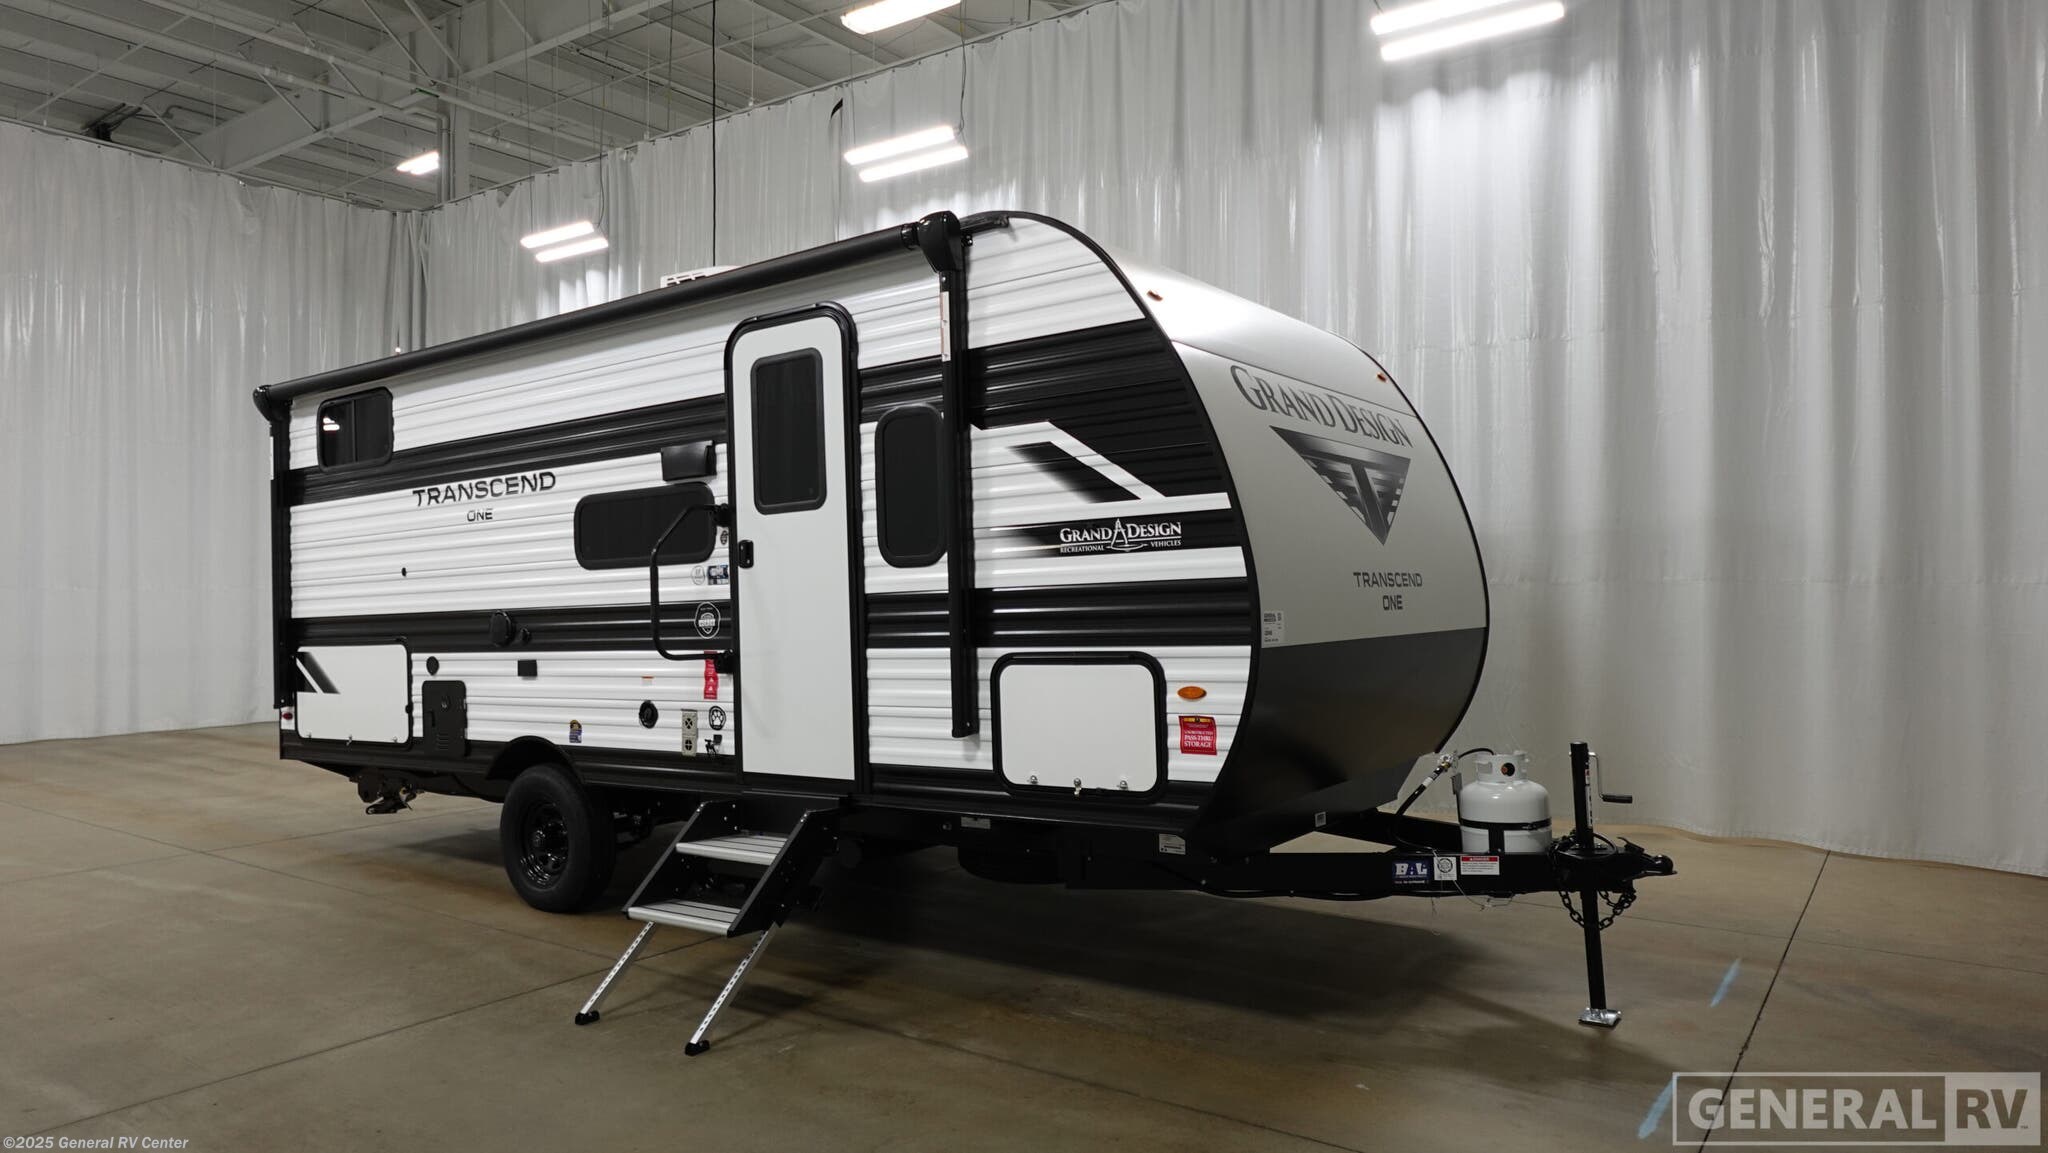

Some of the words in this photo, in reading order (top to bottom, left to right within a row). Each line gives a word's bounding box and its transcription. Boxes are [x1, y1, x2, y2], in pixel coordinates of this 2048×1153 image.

[1230, 365, 1336, 428] GRAND
[1325, 394, 1414, 448] DESIGN
[412, 471, 556, 507] TRANSCEND
[467, 508, 493, 522] ONE
[1060, 527, 1113, 543] GRAND
[1126, 522, 1182, 538] DESIGN
[1060, 545, 1105, 554] RECREATIONAL
[1150, 540, 1182, 548] VEHICLES
[1353, 572, 1423, 588] TRANSCEND
[1382, 595, 1403, 611] ONE
[1184, 740, 1212, 748] STORAGE
